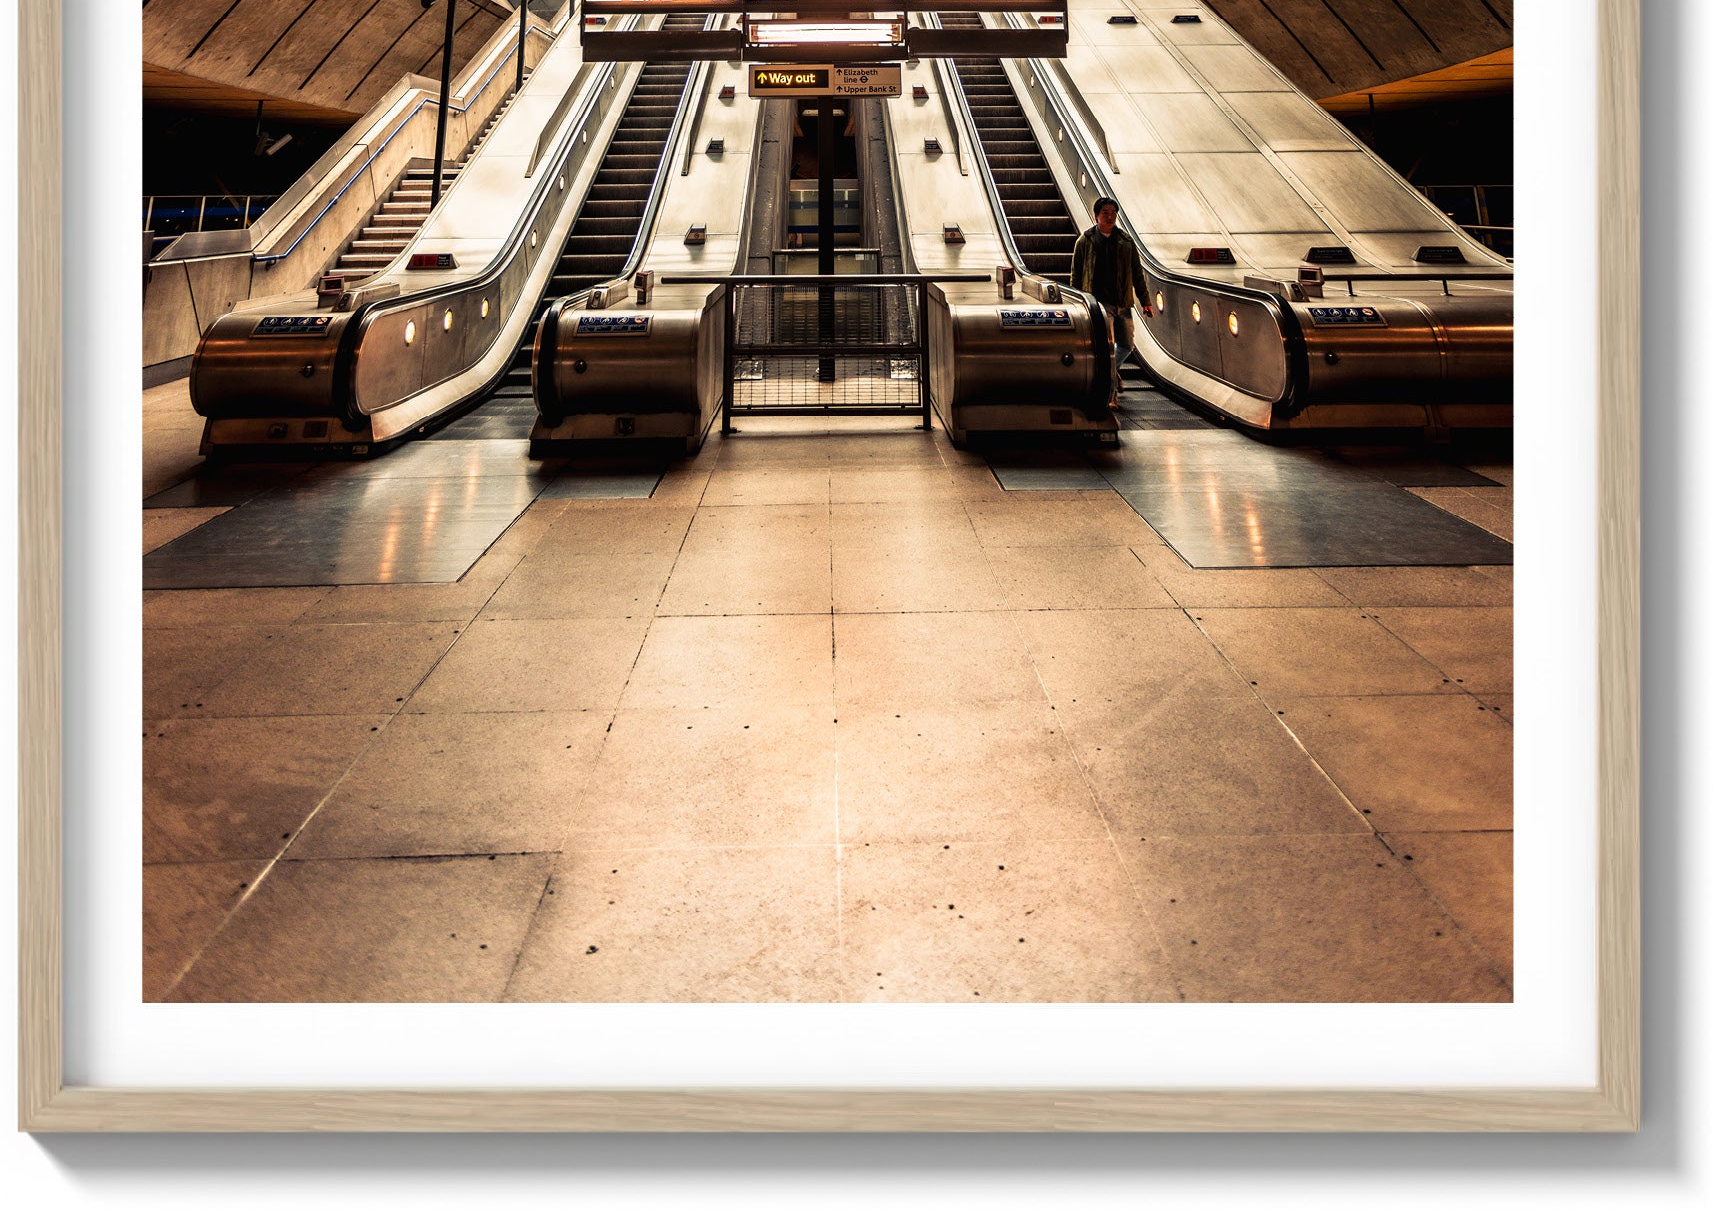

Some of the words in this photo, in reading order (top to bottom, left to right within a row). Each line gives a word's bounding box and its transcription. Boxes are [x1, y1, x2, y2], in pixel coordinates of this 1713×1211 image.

[769, 72, 793, 86] Way
[795, 73, 816, 83] out
[843, 86, 867, 94] Upper
[868, 85, 887, 93] Bank
[888, 85, 897, 93] St
